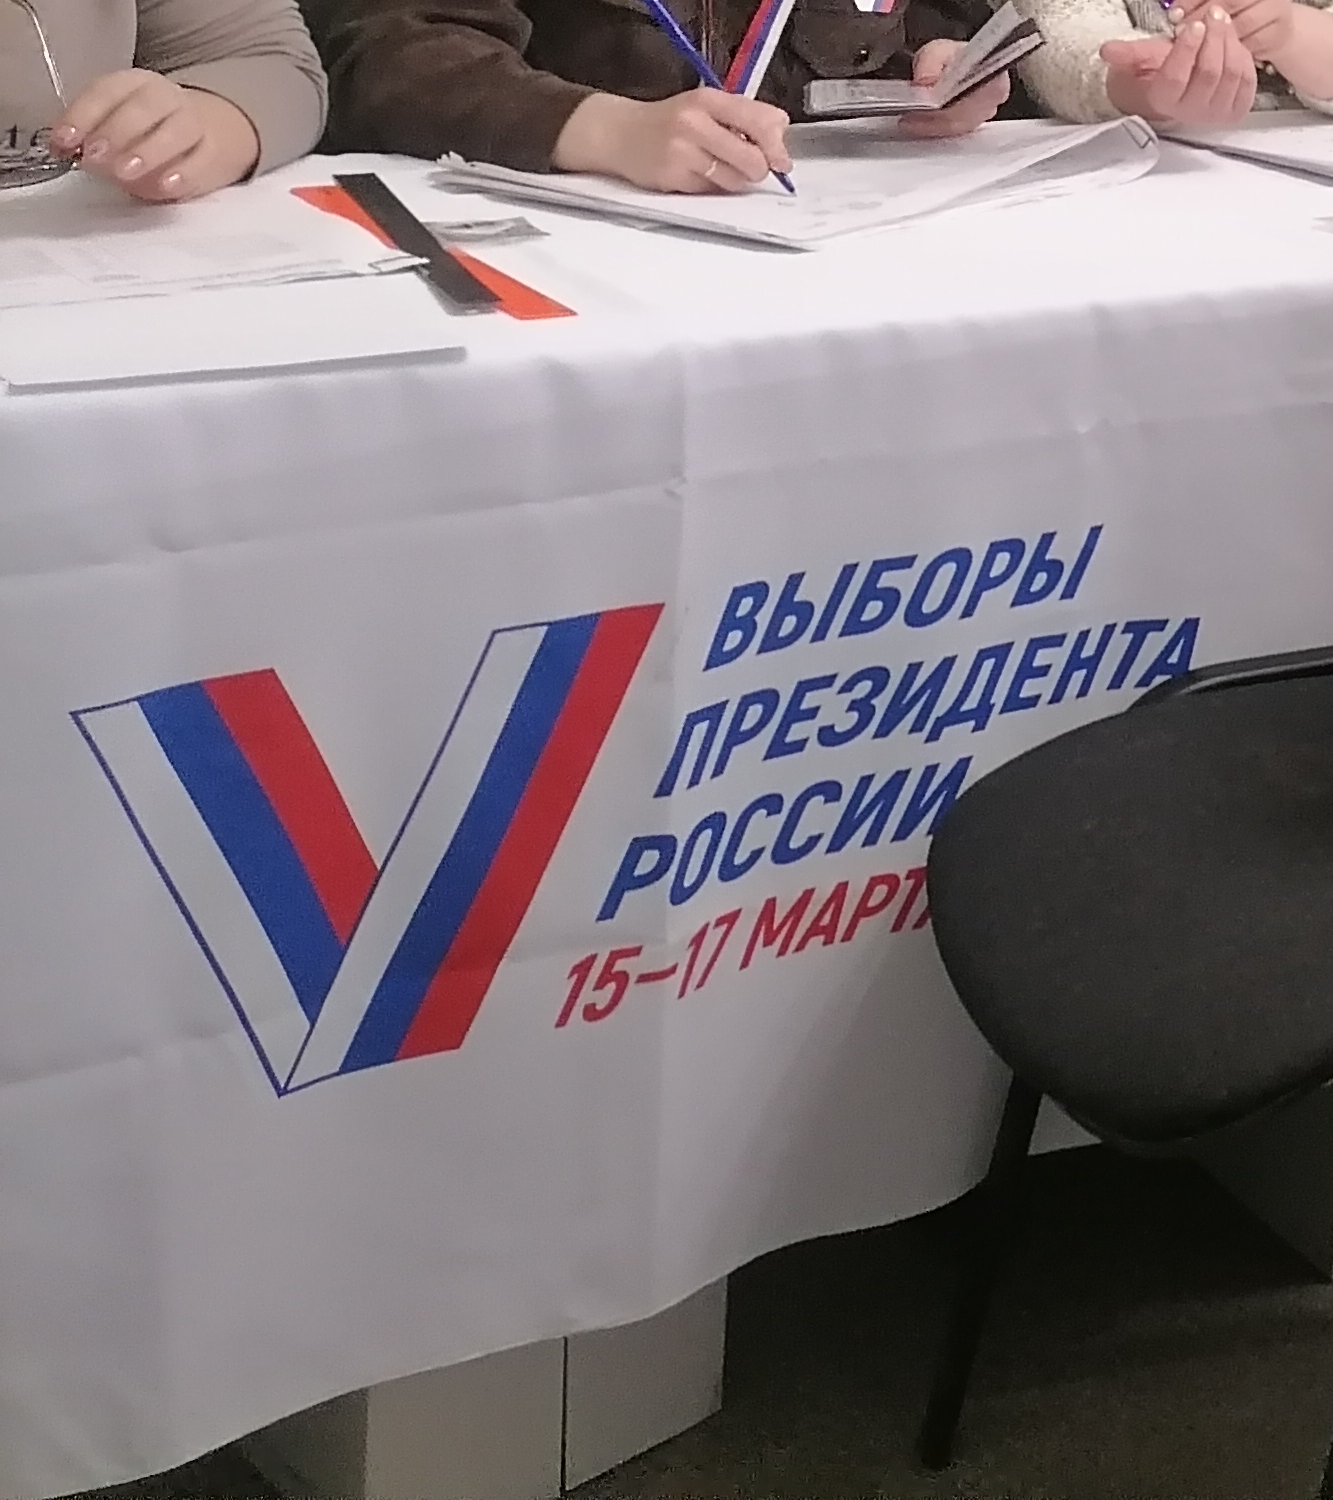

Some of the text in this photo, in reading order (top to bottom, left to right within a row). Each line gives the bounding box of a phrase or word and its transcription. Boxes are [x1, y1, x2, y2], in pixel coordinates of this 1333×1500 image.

[703, 524, 1104, 672] ВЫБОРЫ
[654, 617, 1201, 799] ПРЕЗИДЕНТА
[596, 756, 973, 922] РОССИИ
